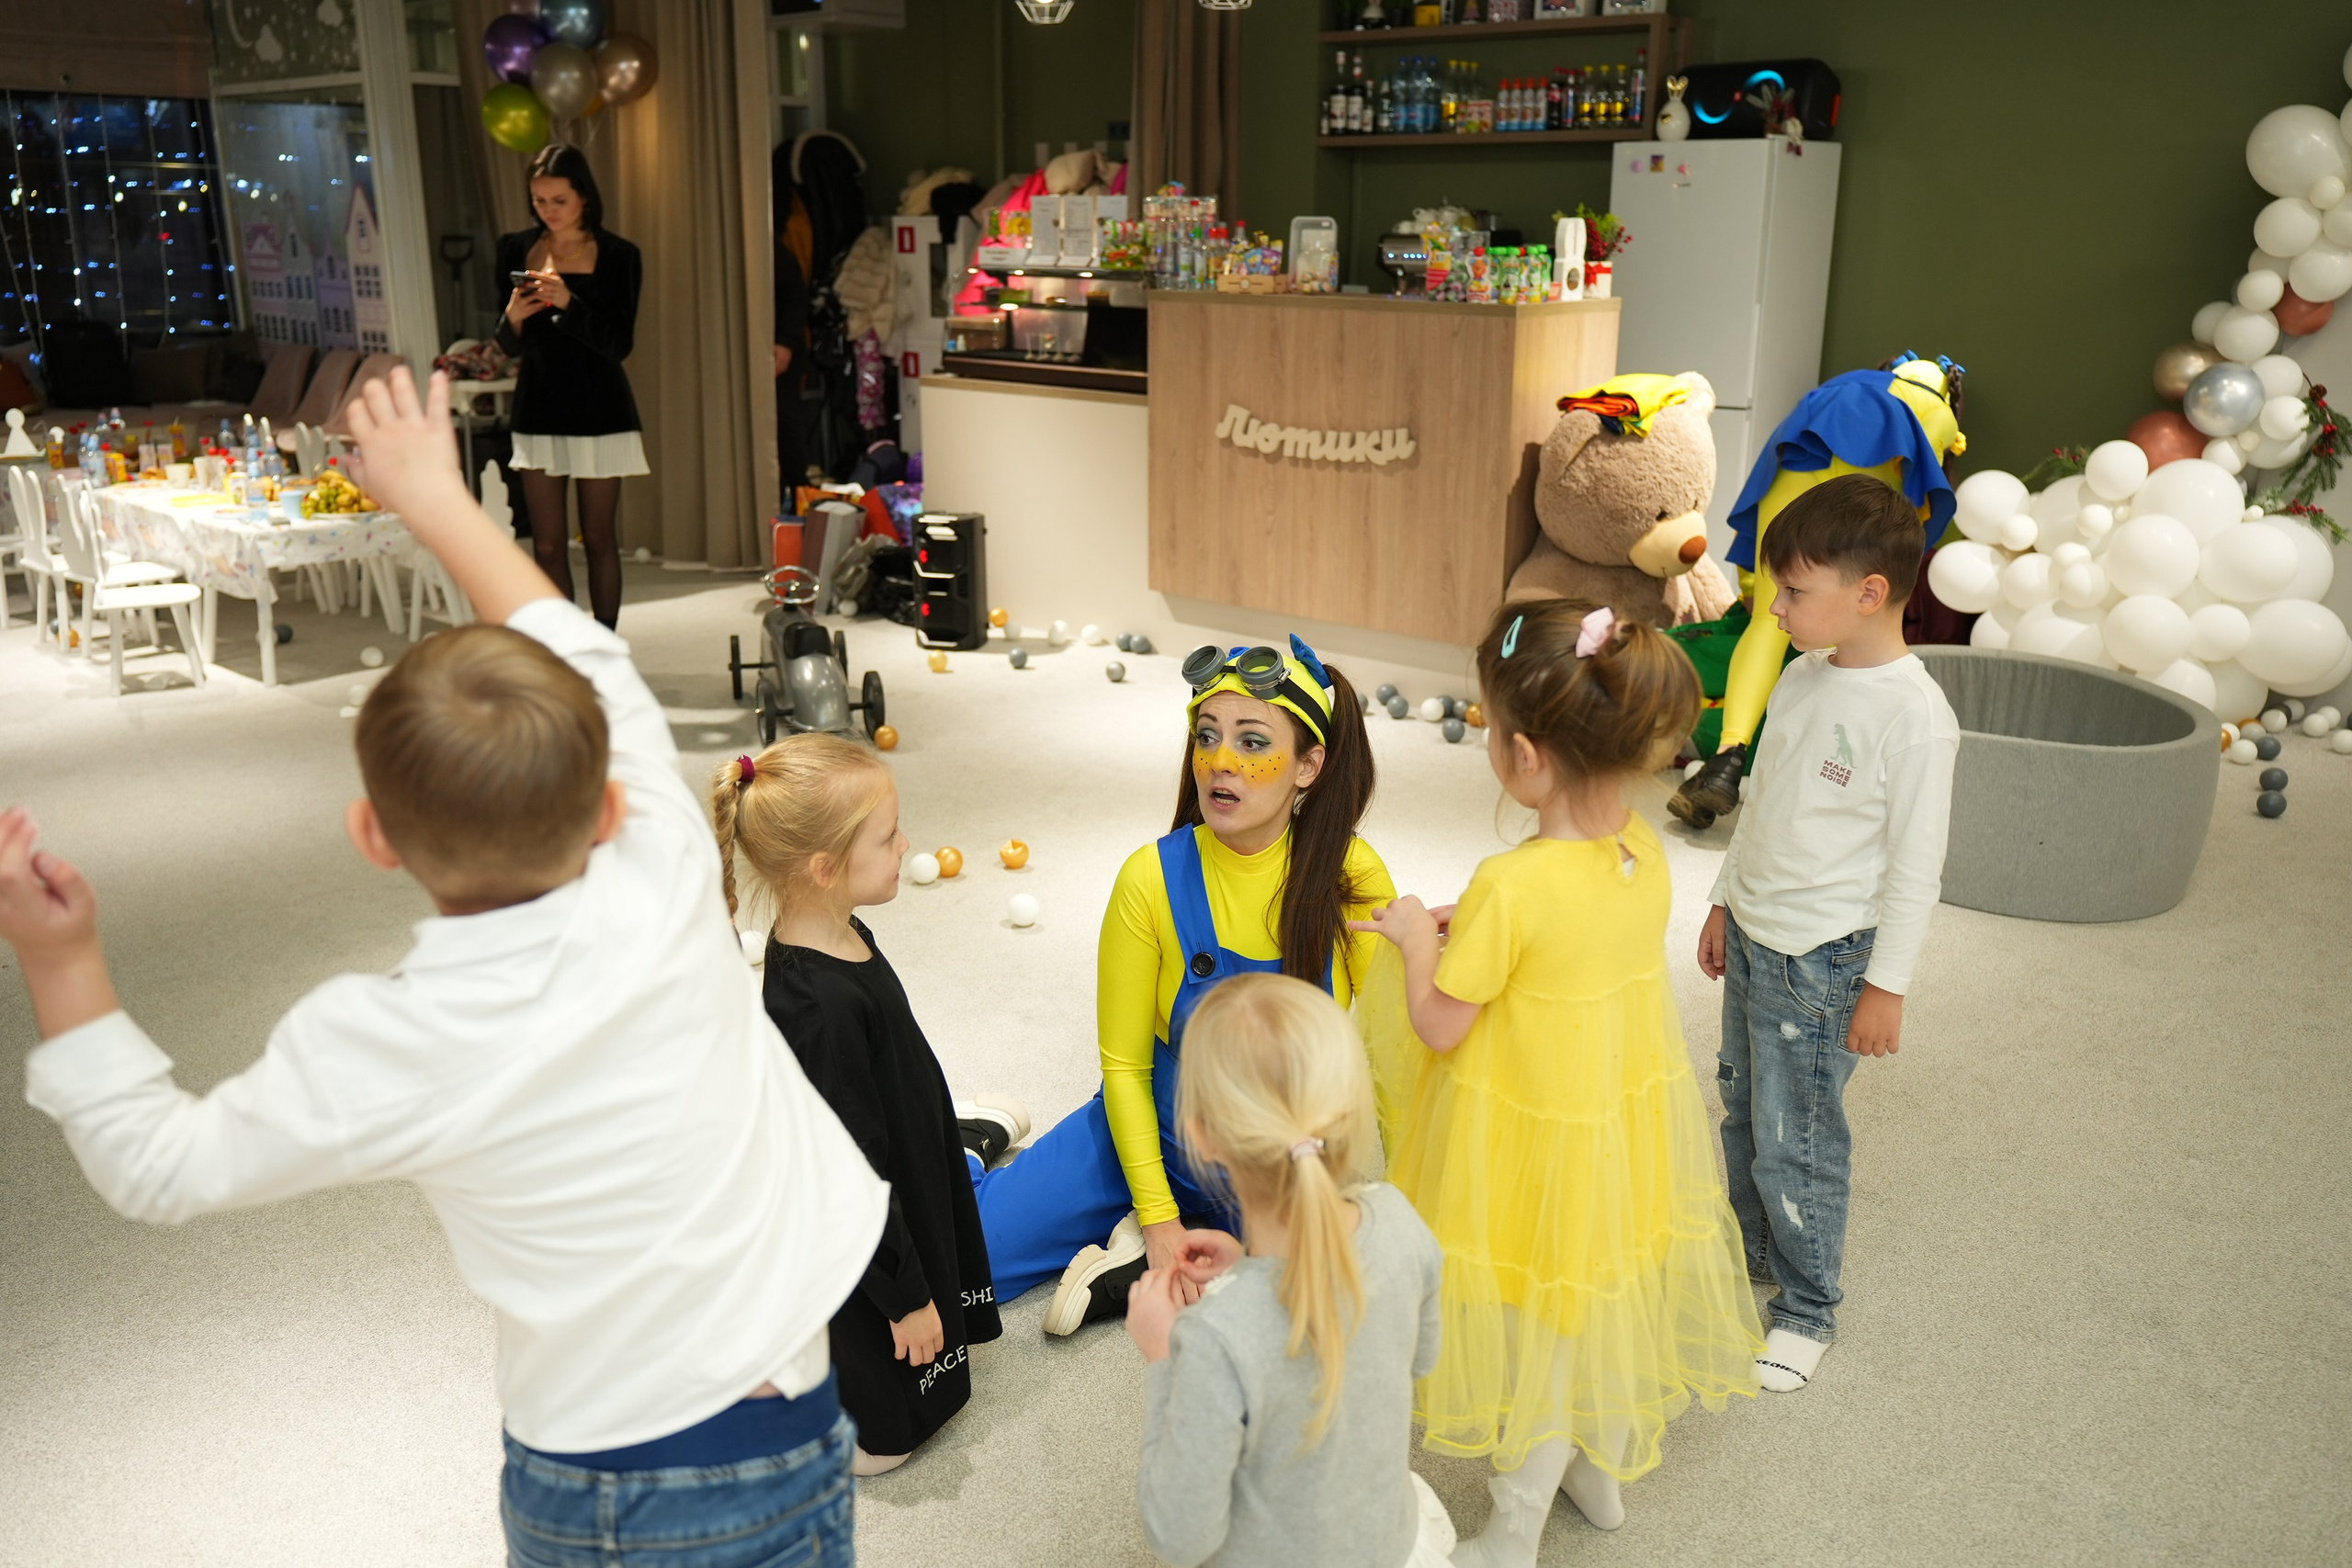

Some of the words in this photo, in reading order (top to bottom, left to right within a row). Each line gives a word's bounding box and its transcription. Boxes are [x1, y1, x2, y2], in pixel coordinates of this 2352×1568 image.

[1215, 404, 1417, 466] Лютики
[1822, 766, 1850, 782] SOME
[1824, 760, 1852, 776] MAKE
[1819, 772, 1848, 787] NOISE
[920, 1345, 967, 1395] PEACE
